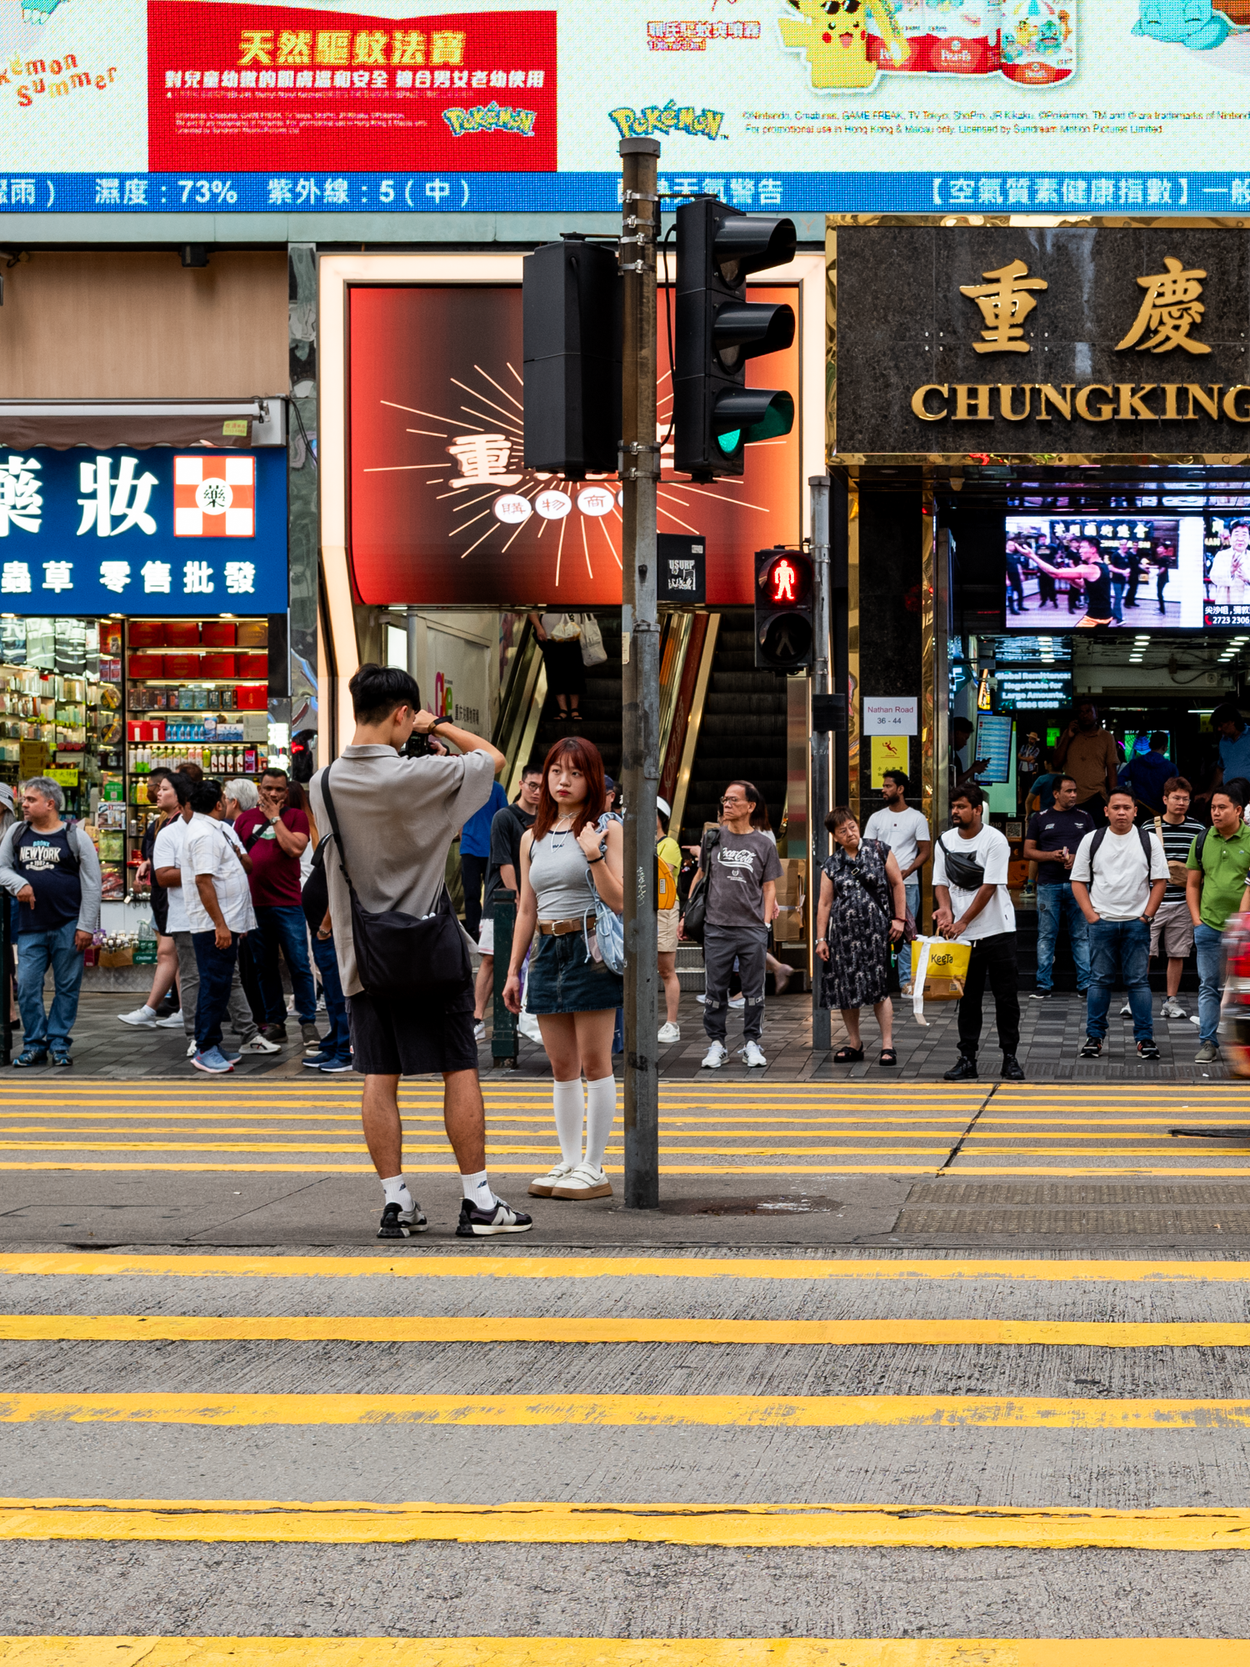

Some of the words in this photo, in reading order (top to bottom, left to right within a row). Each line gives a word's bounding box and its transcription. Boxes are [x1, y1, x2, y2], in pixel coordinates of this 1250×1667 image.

[237, 29, 466, 66] 天然驅蚊法寶
[17, 66, 117, 107] Summer
[1109, 110, 1125, 121] and
[1154, 110, 1203, 121] trademarks
[1206, 110, 1215, 121] of
[746, 125, 759, 135] For
[762, 125, 814, 135] promotional
[817, 125, 832, 135] use
[834, 125, 842, 135] in
[845, 125, 868, 135] Hong
[871, 125, 893, 135] Kong
[959, 125, 998, 135] Licensed
[1000, 125, 1011, 135] by
[1060, 125, 1090, 135] Motion
[1093, 125, 1127, 135] Pictures
[99, 561, 256, 594] 零售批發
[1212, 616, 1231, 625] 2723
[1231, 616, 1250, 625] 2306
[995, 672, 1021, 680] Global
[1003, 682, 1048, 691] Negotiable
[1049, 682, 1063, 690] for
[1002, 692, 1026, 700] Large
[867, 706, 893, 714] Nathan
[894, 706, 914, 714] Road
[877, 717, 886, 725] 36
[892, 717, 902, 725] 44
[931, 953, 953, 966] KeeTa
